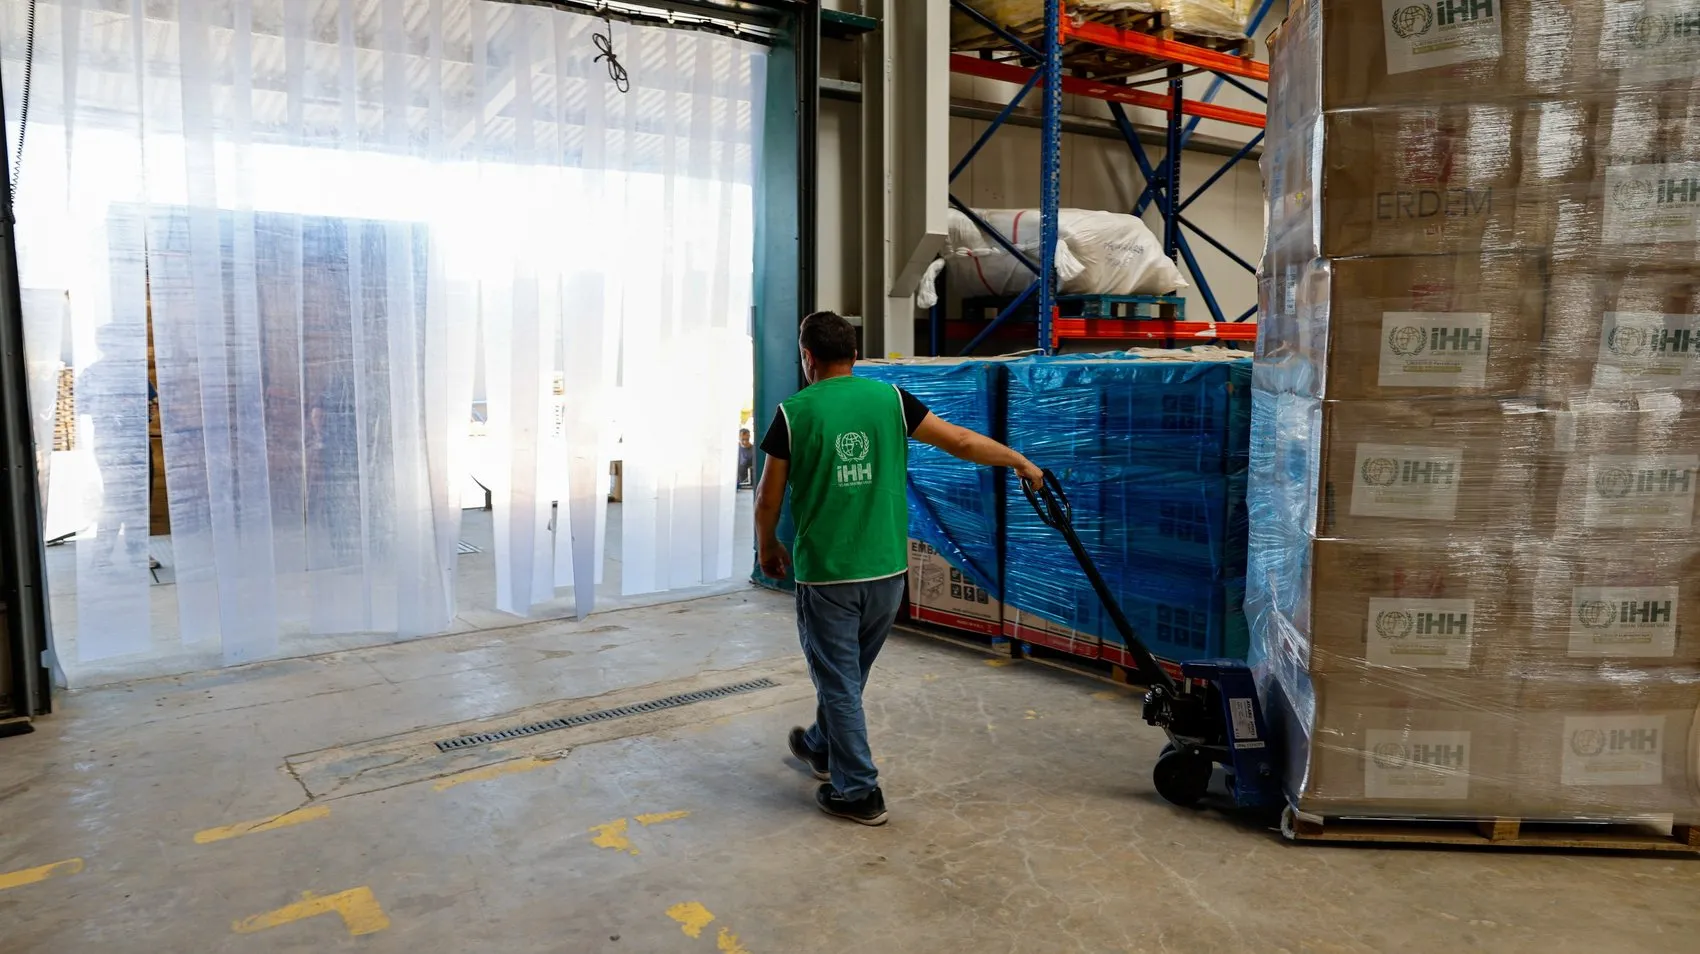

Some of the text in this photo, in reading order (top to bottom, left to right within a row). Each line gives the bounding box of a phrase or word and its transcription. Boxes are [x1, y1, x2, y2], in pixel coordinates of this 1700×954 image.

[1674, 12, 1700, 37] iH
[1376, 186, 1492, 219] ERDEM
[1430, 327, 1482, 350] iHH
[837, 463, 872, 483] iHH
[1402, 461, 1455, 484] iHH
[1637, 469, 1691, 492] iHH
[1620, 600, 1671, 622] iHH
[1416, 612, 1468, 634] iHH
[1608, 729, 1658, 750] iHH
[1413, 744, 1464, 765] iHH
